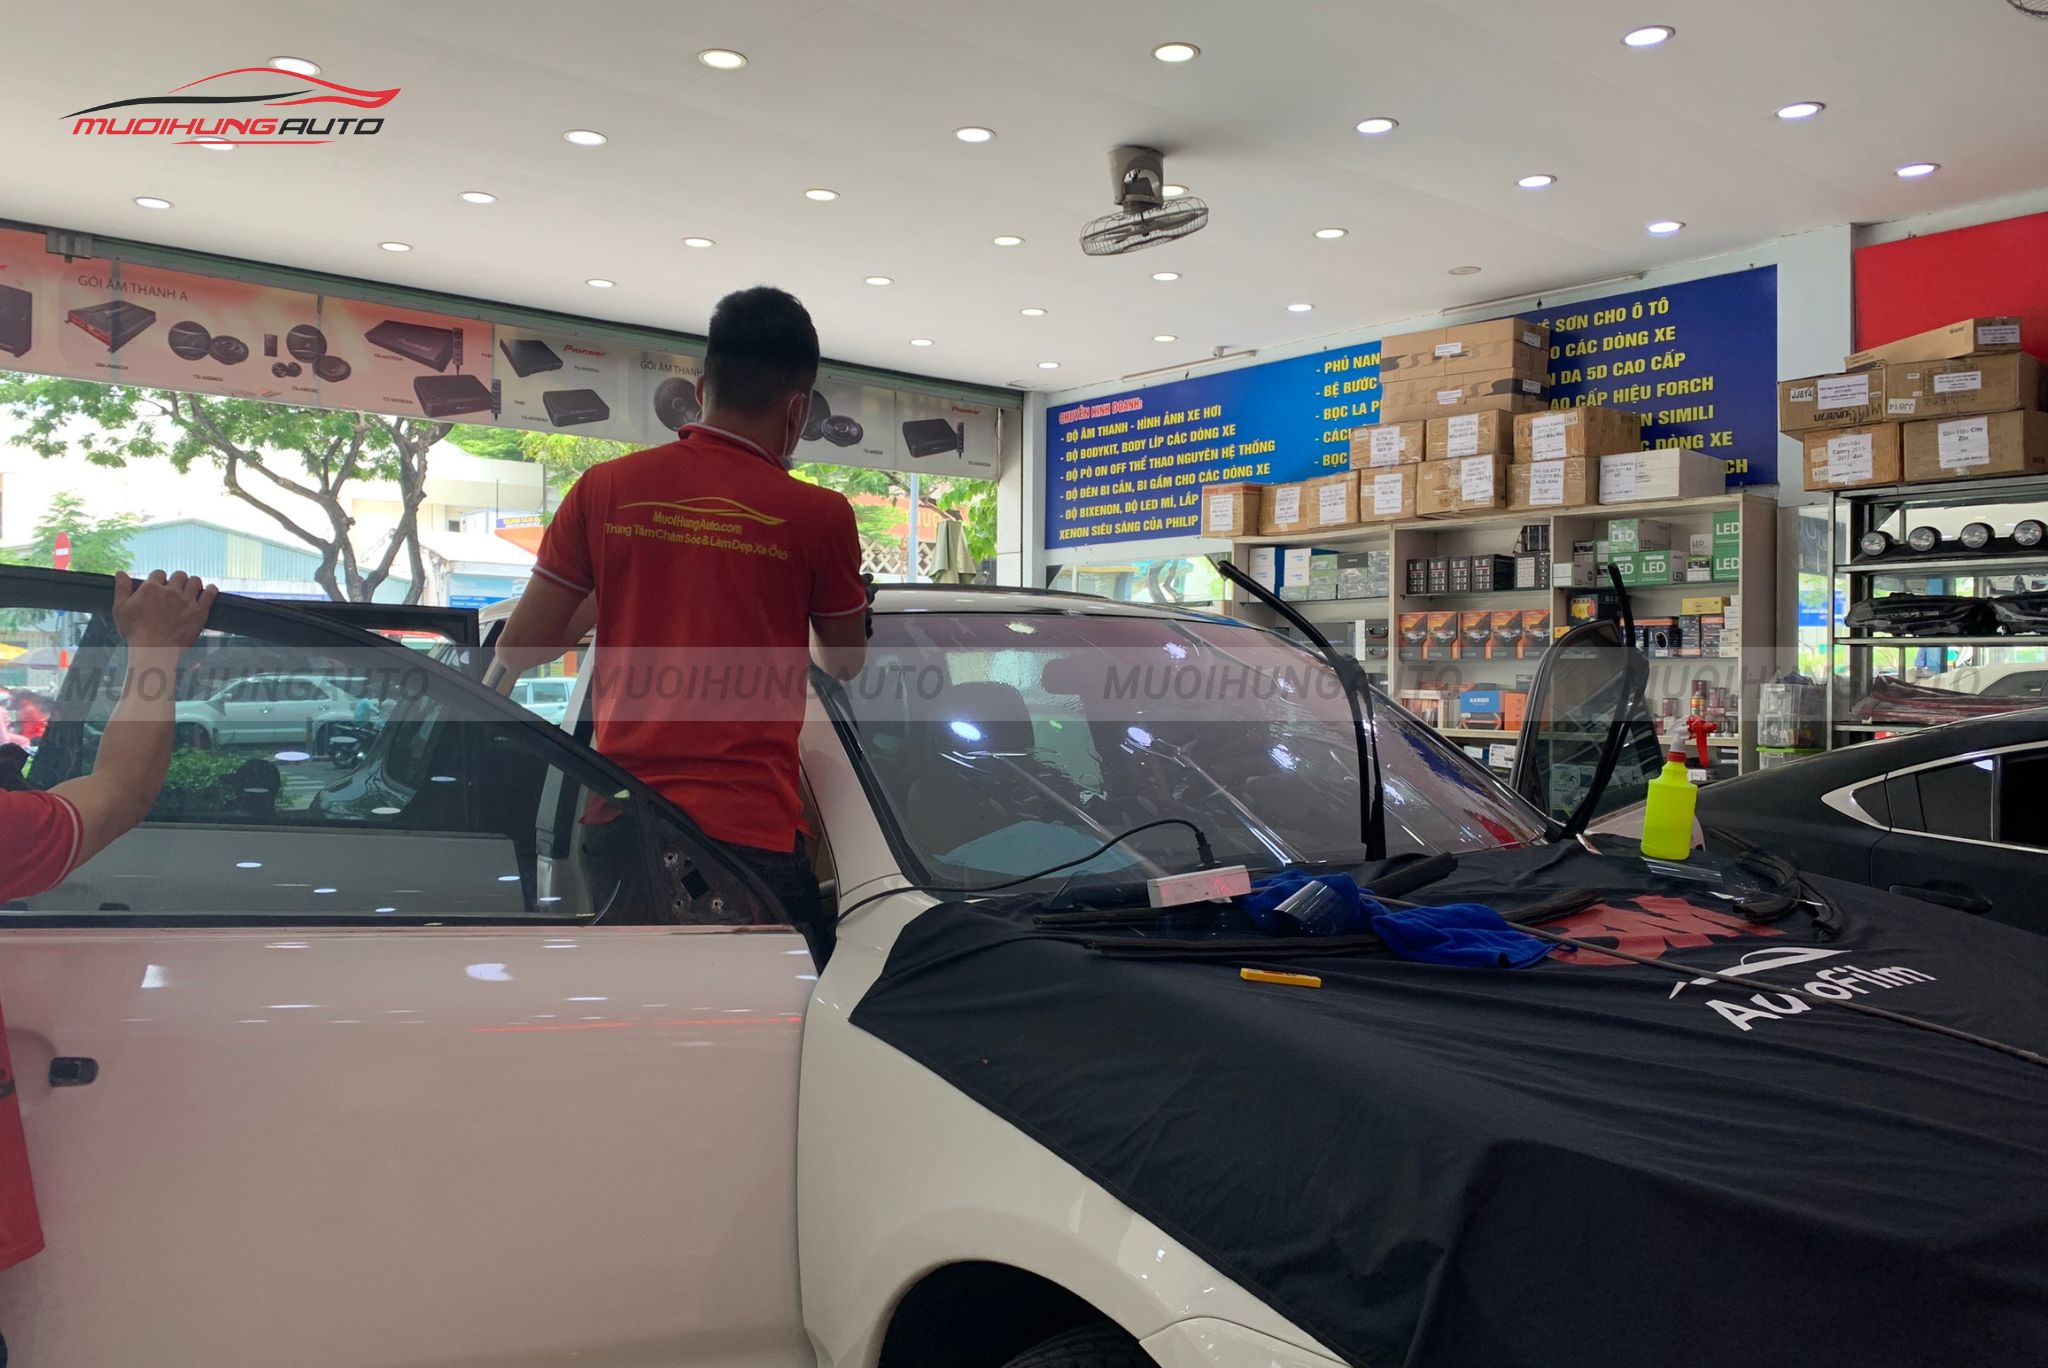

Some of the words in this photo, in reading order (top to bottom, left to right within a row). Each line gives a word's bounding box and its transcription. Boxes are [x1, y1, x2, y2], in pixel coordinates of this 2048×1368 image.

[131, 283, 176, 299] THANH
[179, 290, 188, 301] A
[1324, 355, 1349, 374] PHỦ
[1353, 353, 1381, 368] NAN
[1555, 314, 1588, 332] SƠN
[1594, 307, 1627, 326] CHO
[1632, 302, 1643, 319] Ô
[1648, 297, 1669, 316] TÔ
[563, 344, 606, 358] Pioneer
[1323, 381, 1339, 398] BỆ
[1343, 377, 1377, 394] BƯỚC
[1565, 338, 1598, 357] CÁC
[1602, 332, 1649, 351] DÒNG
[1654, 326, 1676, 343] XE
[1323, 406, 1348, 421] BỌC
[1352, 402, 1367, 416] LA
[1371, 400, 1383, 413] P
[1561, 368, 1582, 385] DA
[1587, 364, 1608, 380] 5D
[1613, 358, 1646, 377] CAO
[1651, 348, 1686, 370] CẤP
[1575, 387, 1608, 407] CẤP
[1613, 383, 1652, 404] HIỆU
[1657, 376, 1714, 397] FORCH
[1059, 405, 1090, 424] CHUYÊN
[1091, 402, 1111, 418] KINH
[1066, 429, 1078, 443] ĐỘ
[1081, 427, 1095, 440] ÂM
[1097, 422, 1128, 437] THANH
[1137, 416, 1160, 430] HÌNH
[1163, 411, 1184, 426] ẢNH
[1187, 408, 1200, 421] XE
[1203, 404, 1222, 419] HƠI
[1066, 449, 1078, 463] ĐỘ
[1080, 444, 1119, 459] BODYKIT,
[1122, 439, 1146, 453] BODY
[1149, 434, 1164, 449] LÍP
[1167, 431, 1187, 446] CÁC
[1190, 427, 1219, 442] DÒNG
[1222, 424, 1236, 437] XE
[1322, 452, 1348, 468] BỌC
[1658, 404, 1714, 425] SIMILI
[1710, 431, 1733, 447] XE
[1066, 468, 1078, 482] ĐỘ
[1080, 465, 1092, 479] PÔ
[1095, 465, 1108, 477] ON
[1110, 462, 1126, 475] OFF
[1129, 455, 1146, 472] THỂ
[1149, 455, 1174, 469] THAO
[1177, 448, 1218, 465] NGUYÊN
[1222, 444, 1235, 460] HỆ
[1239, 438, 1275, 456] THỐNG
[1066, 487, 1078, 502] ĐỘ
[1080, 485, 1098, 499] ĐÈN
[1101, 485, 1110, 496] BI
[1137, 480, 1147, 491] BI
[1175, 473, 1195, 486] CHO
[1199, 468, 1219, 483] CÁC
[1223, 465, 1253, 480] DÒNG
[1256, 463, 1270, 475] XE
[1065, 507, 1077, 521] ĐỘ
[1080, 503, 1122, 518] BIXENON,
[1125, 499, 1137, 514] ĐỘ
[1140, 498, 1158, 511] LED
[1179, 491, 1199, 506] LẮP
[604, 523, 632, 536] Trung
[633, 524, 654, 538] Tâm
[702, 535, 710, 545] &
[753, 543, 767, 555] Xe
[1059, 527, 1089, 540] XENON
[1091, 522, 1112, 536] SIÊU
[1115, 520, 1140, 534] SÁNG
[1143, 516, 1163, 531] CỦA
[1166, 515, 1199, 528] PHILIP
[1611, 529, 1635, 541] LED
[1716, 522, 1740, 535] LED
[1618, 563, 1634, 575] ED
[1642, 561, 1666, 573] LED
[1673, 571, 1684, 581] LED
[1716, 557, 1740, 570] LED
